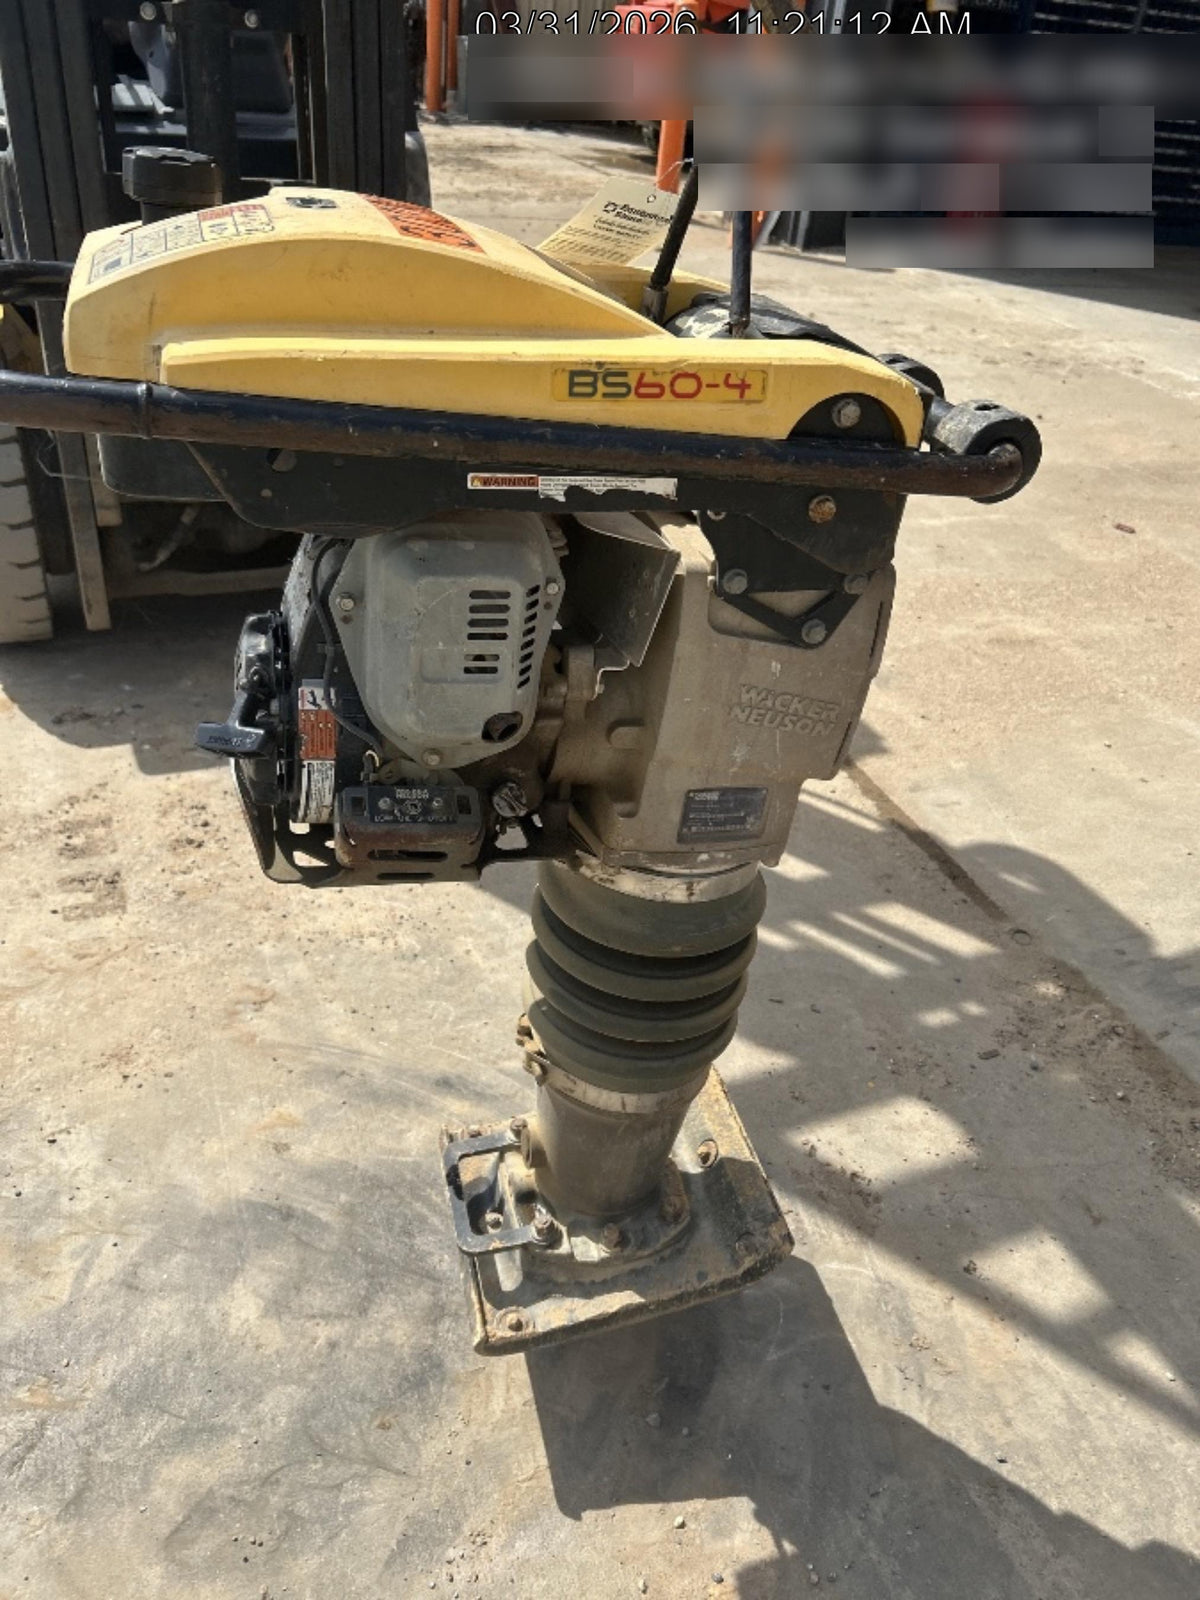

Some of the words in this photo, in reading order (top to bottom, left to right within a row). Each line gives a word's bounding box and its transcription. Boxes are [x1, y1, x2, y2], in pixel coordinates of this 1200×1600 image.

[568, 369, 752, 399] BS60-4
[483, 475, 536, 488] WARNING
[740, 683, 840, 722] WACKER
[729, 704, 835, 737] NEUSON
